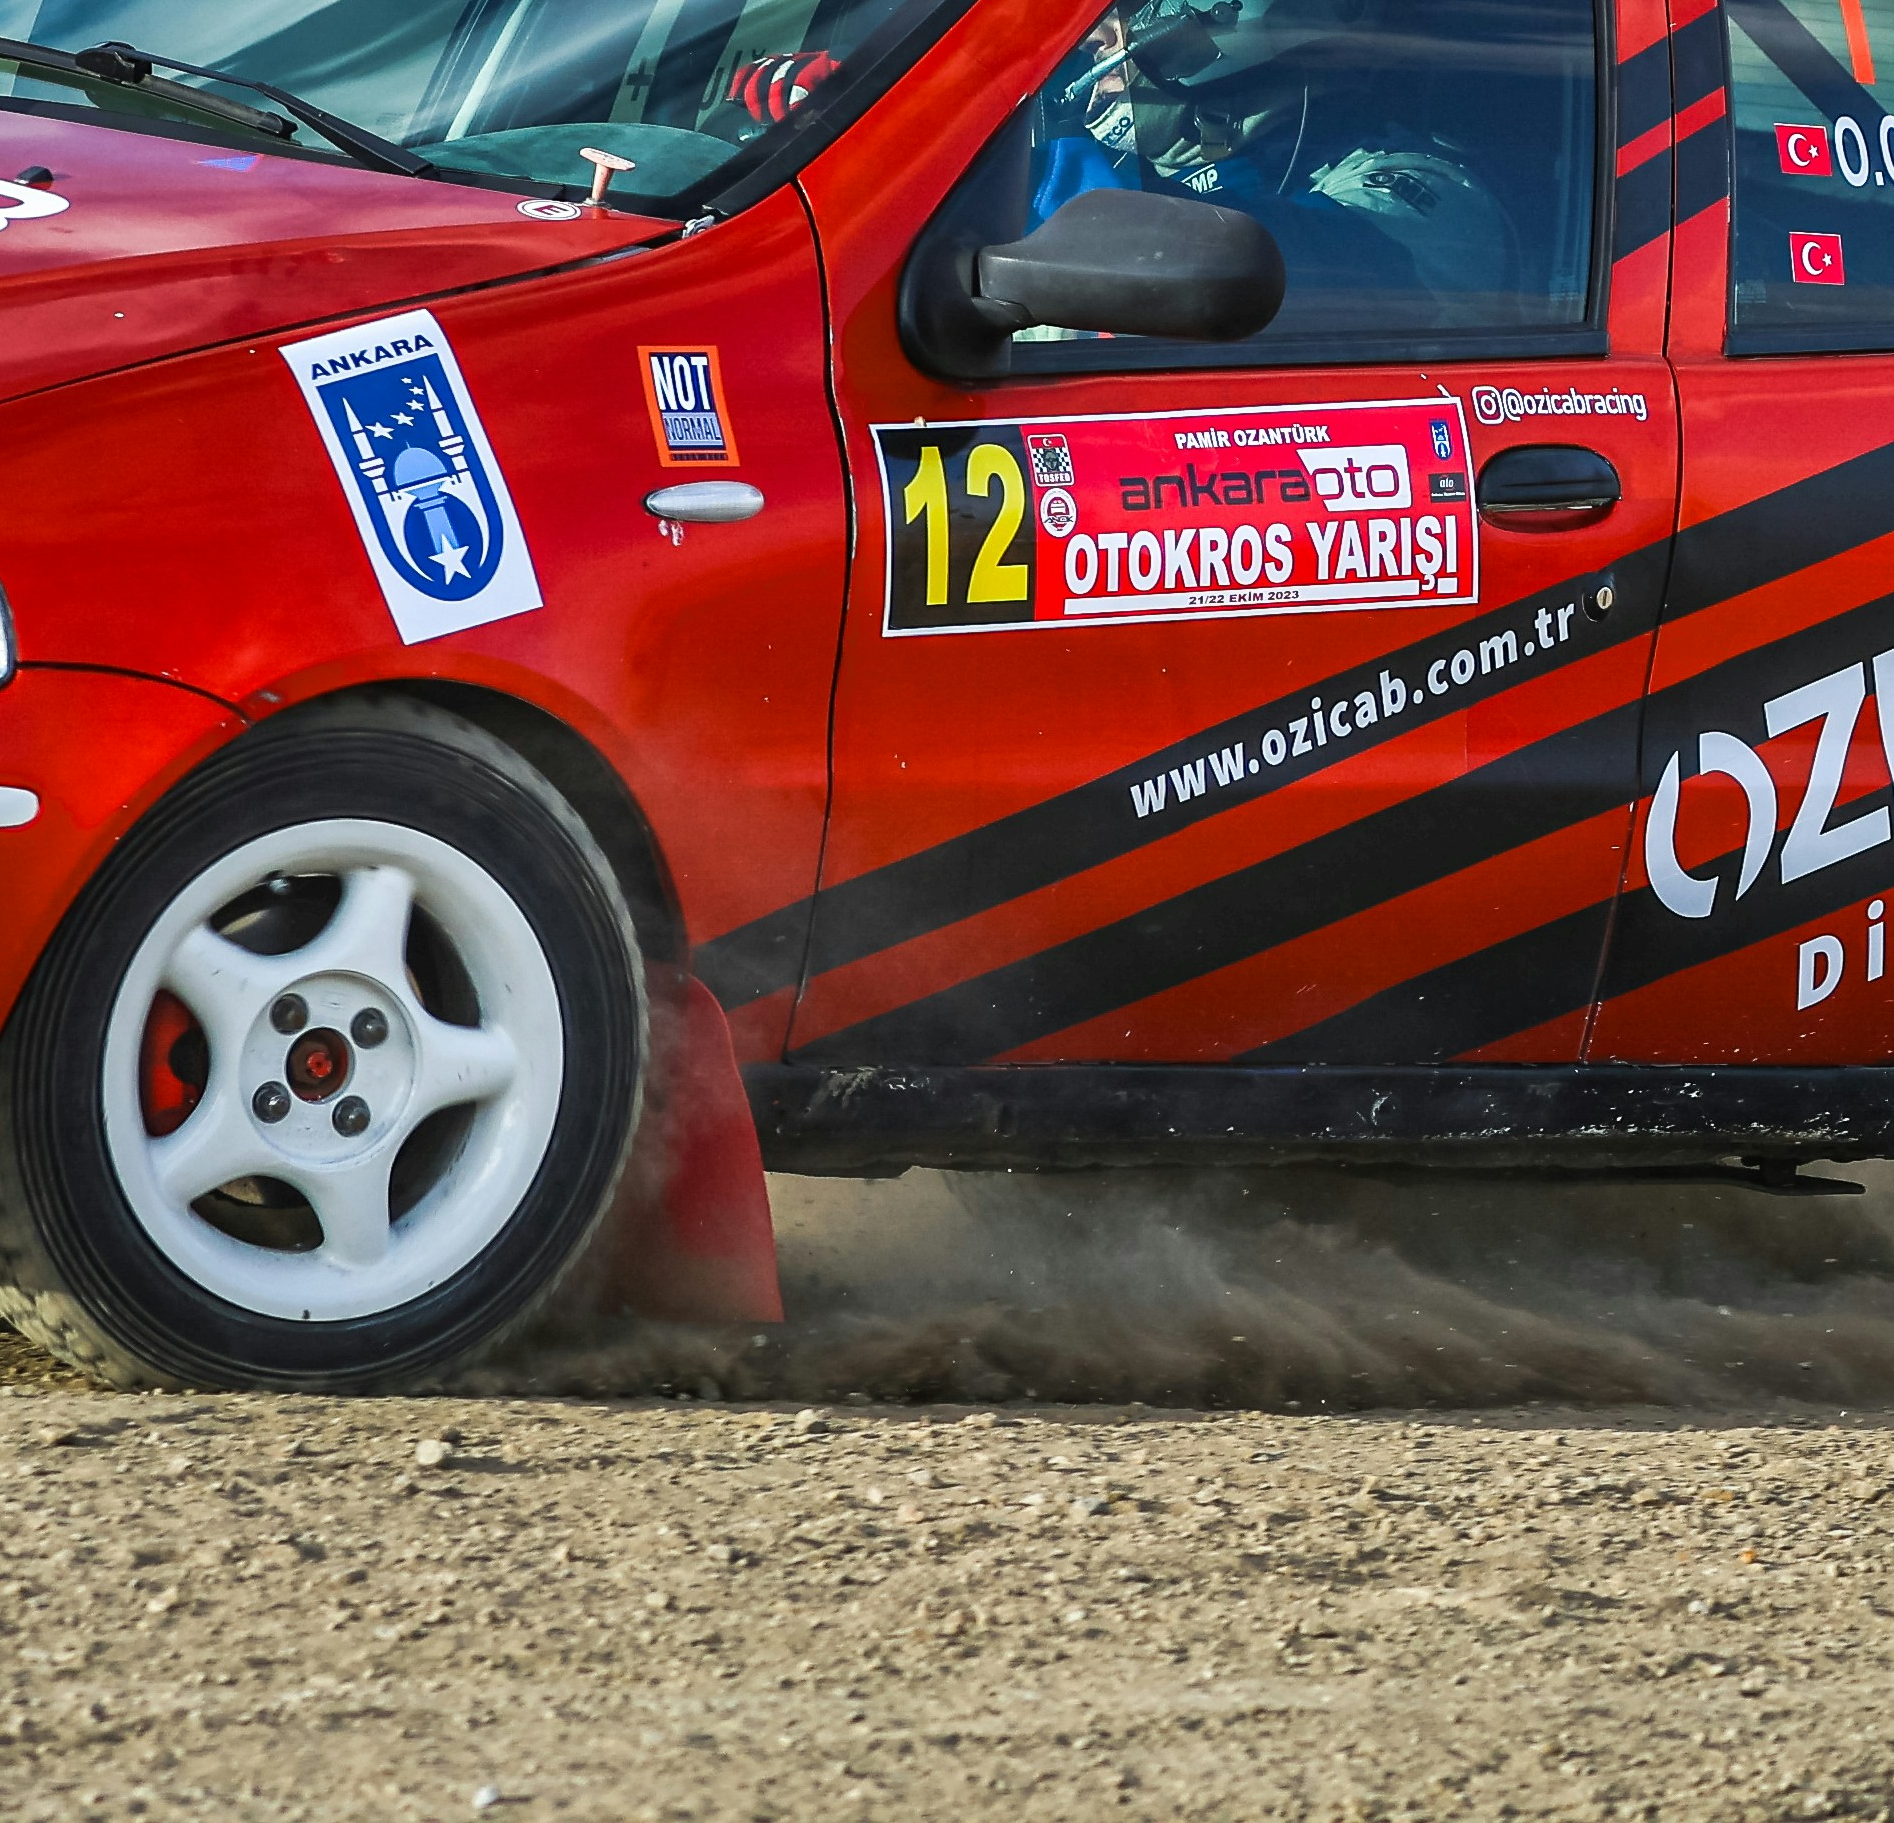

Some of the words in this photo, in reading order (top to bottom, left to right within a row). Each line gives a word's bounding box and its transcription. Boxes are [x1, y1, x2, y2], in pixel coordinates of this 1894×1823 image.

[310, 333, 435, 381] ANKARA
[649, 355, 712, 412] NOT
[1503, 386, 1649, 422] @ozicabracing
[663, 417, 723, 441] NORMAL
[1174, 426, 1230, 450] PAMİR
[1233, 424, 1331, 446] OZANTÜRK
[903, 442, 1030, 607] 12
[1064, 523, 1293, 596] OTOKROS
[1305, 514, 1458, 592] YARIŞI
[1187, 593, 1225, 606] 21/22
[1228, 589, 1265, 604] EKİM
[1267, 589, 1300, 602] 2023
[1129, 599, 1577, 820] www.ozicab.com.tr
